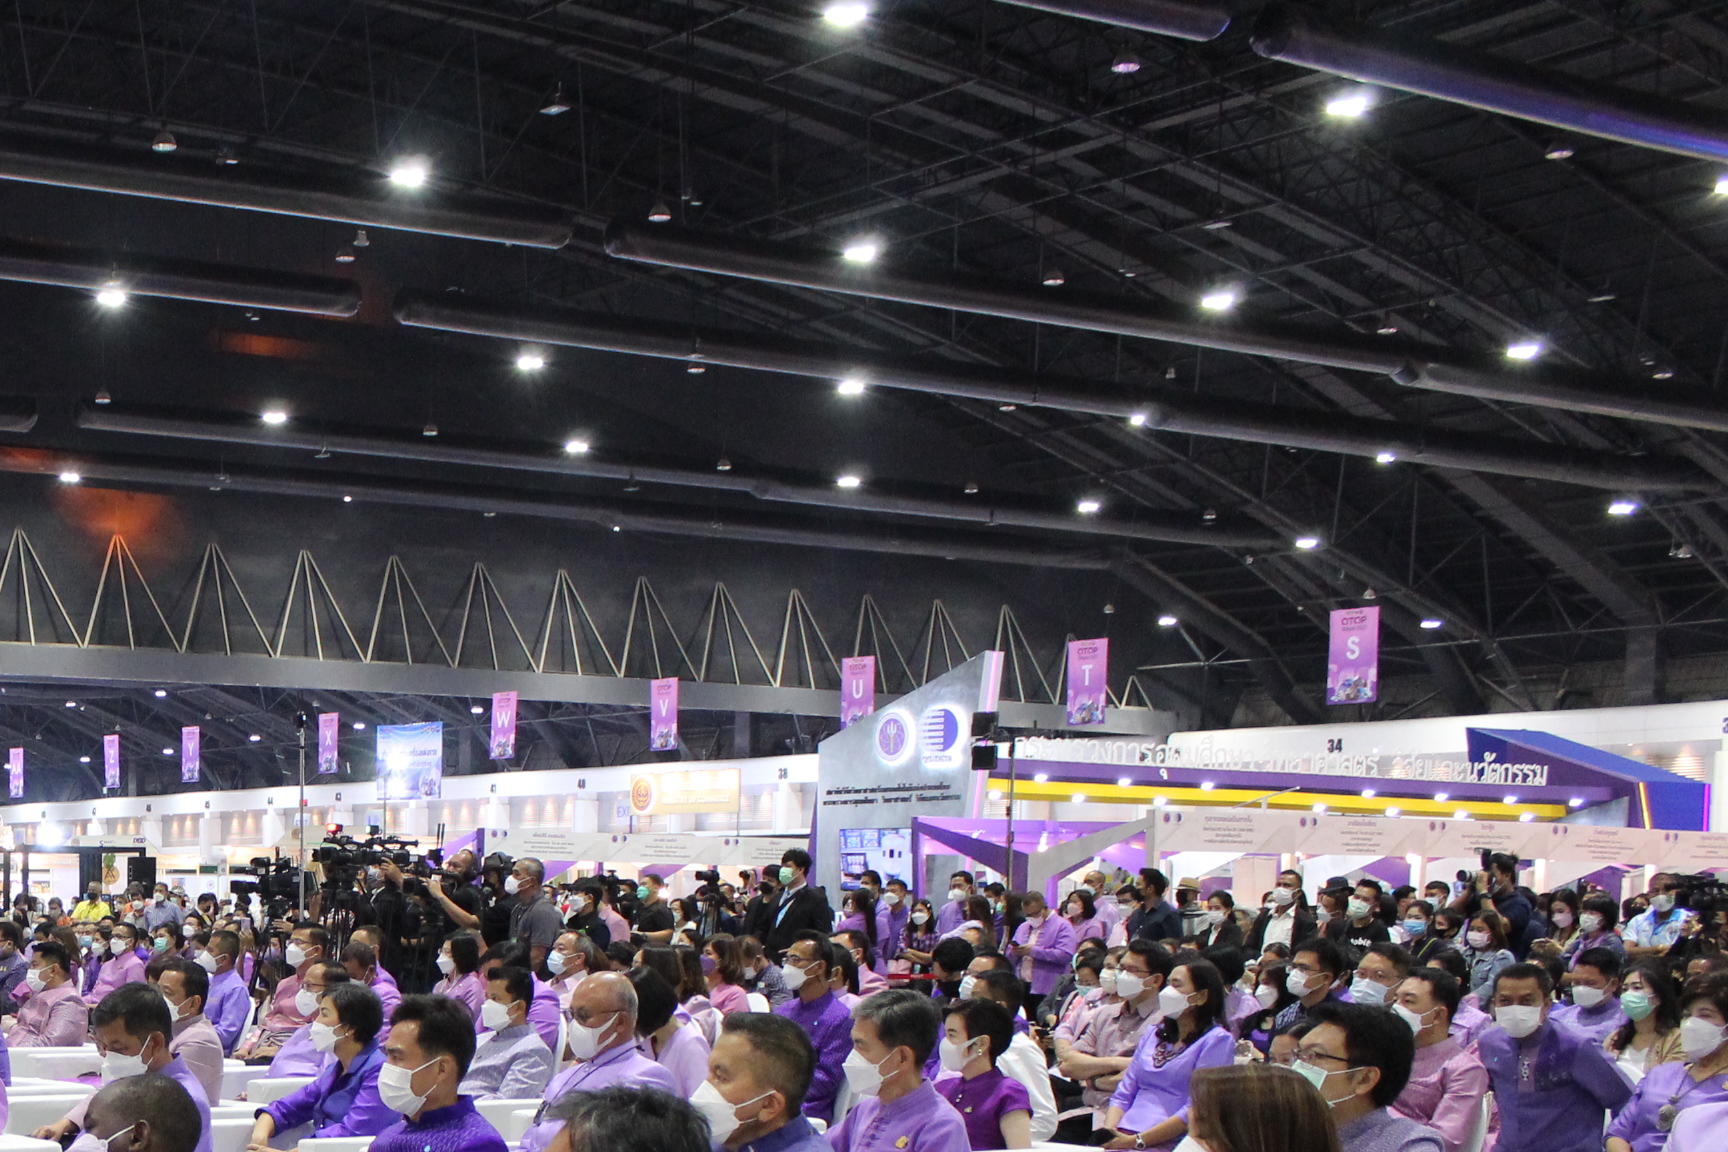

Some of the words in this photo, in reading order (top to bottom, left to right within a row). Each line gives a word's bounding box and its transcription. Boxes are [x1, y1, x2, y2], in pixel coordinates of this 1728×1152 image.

[1345, 635, 1361, 660] S
[1081, 664, 1094, 687] T
[852, 679, 863, 700] U
[659, 698, 669, 718] V
[496, 710, 511, 729] W
[325, 730, 332, 747] X
[1327, 738, 1343, 754] 34
[108, 750, 115, 764] Z
[187, 742, 194, 757] Y
[778, 767, 788, 780] 38
[617, 806, 631, 818] EXI
